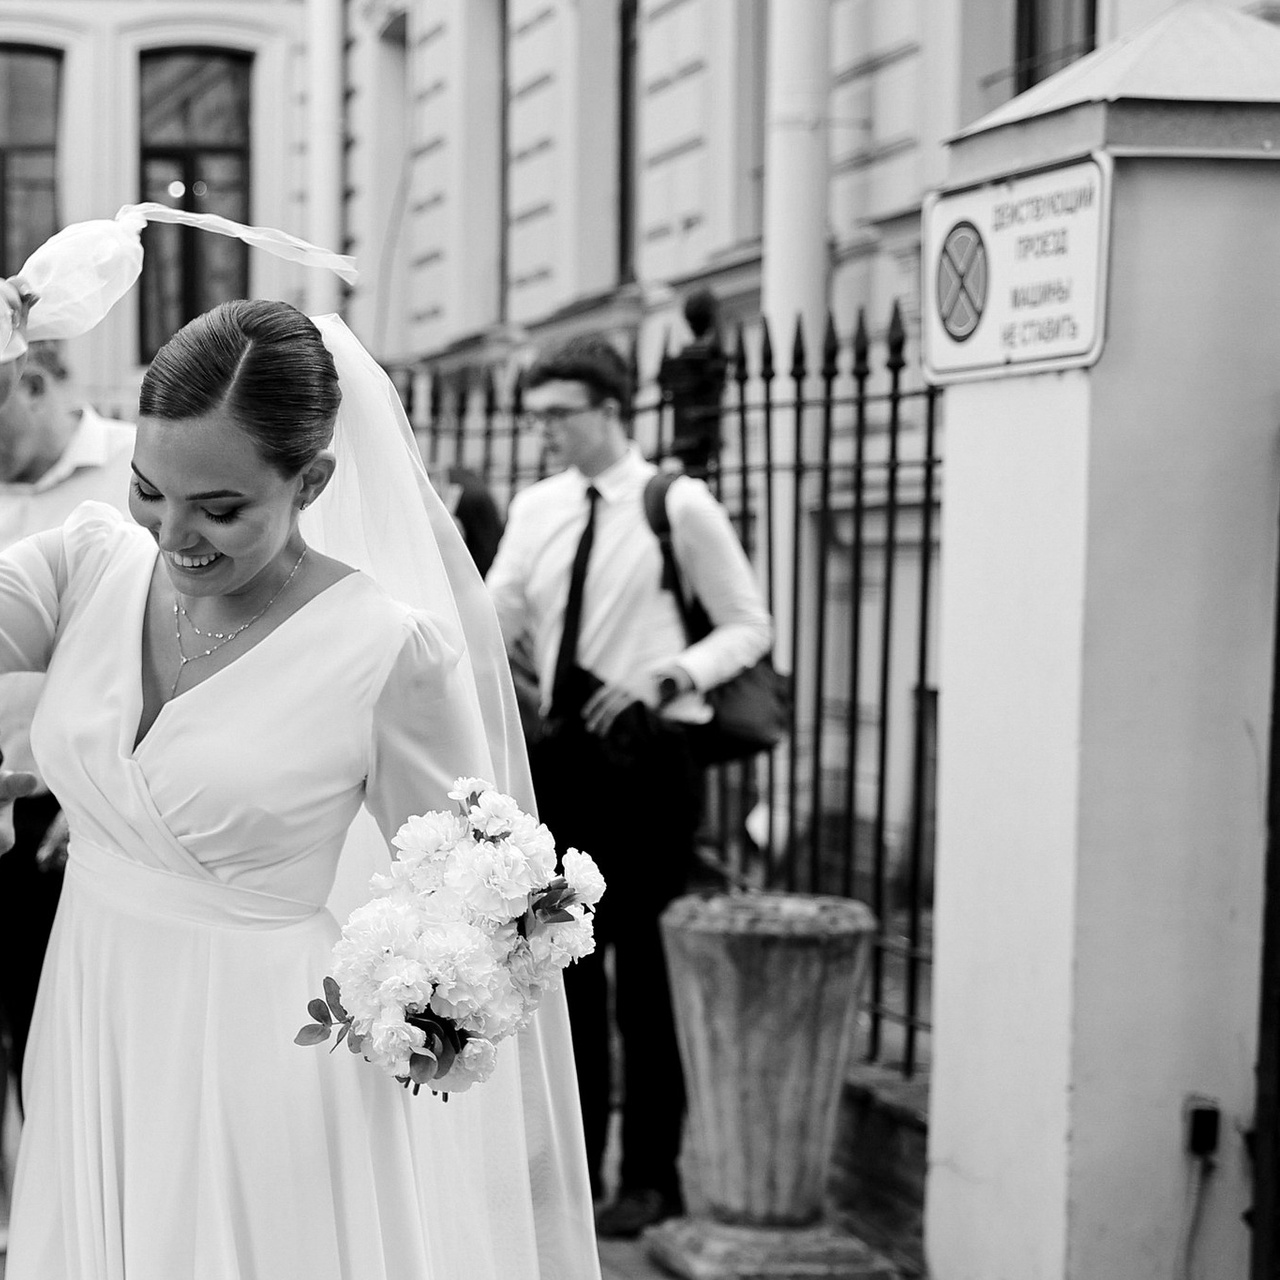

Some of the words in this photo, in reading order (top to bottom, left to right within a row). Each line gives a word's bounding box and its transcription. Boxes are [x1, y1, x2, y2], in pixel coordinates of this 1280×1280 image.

[991, 180, 1095, 231] ДЕЙСТВУЮЩИЙ
[1017, 227, 1068, 259] ПРОЕЗД
[1010, 279, 1072, 309] МАШИНЫ
[1001, 321, 1017, 348] НЕ
[1021, 314, 1079, 346] СТАВИТЬ
